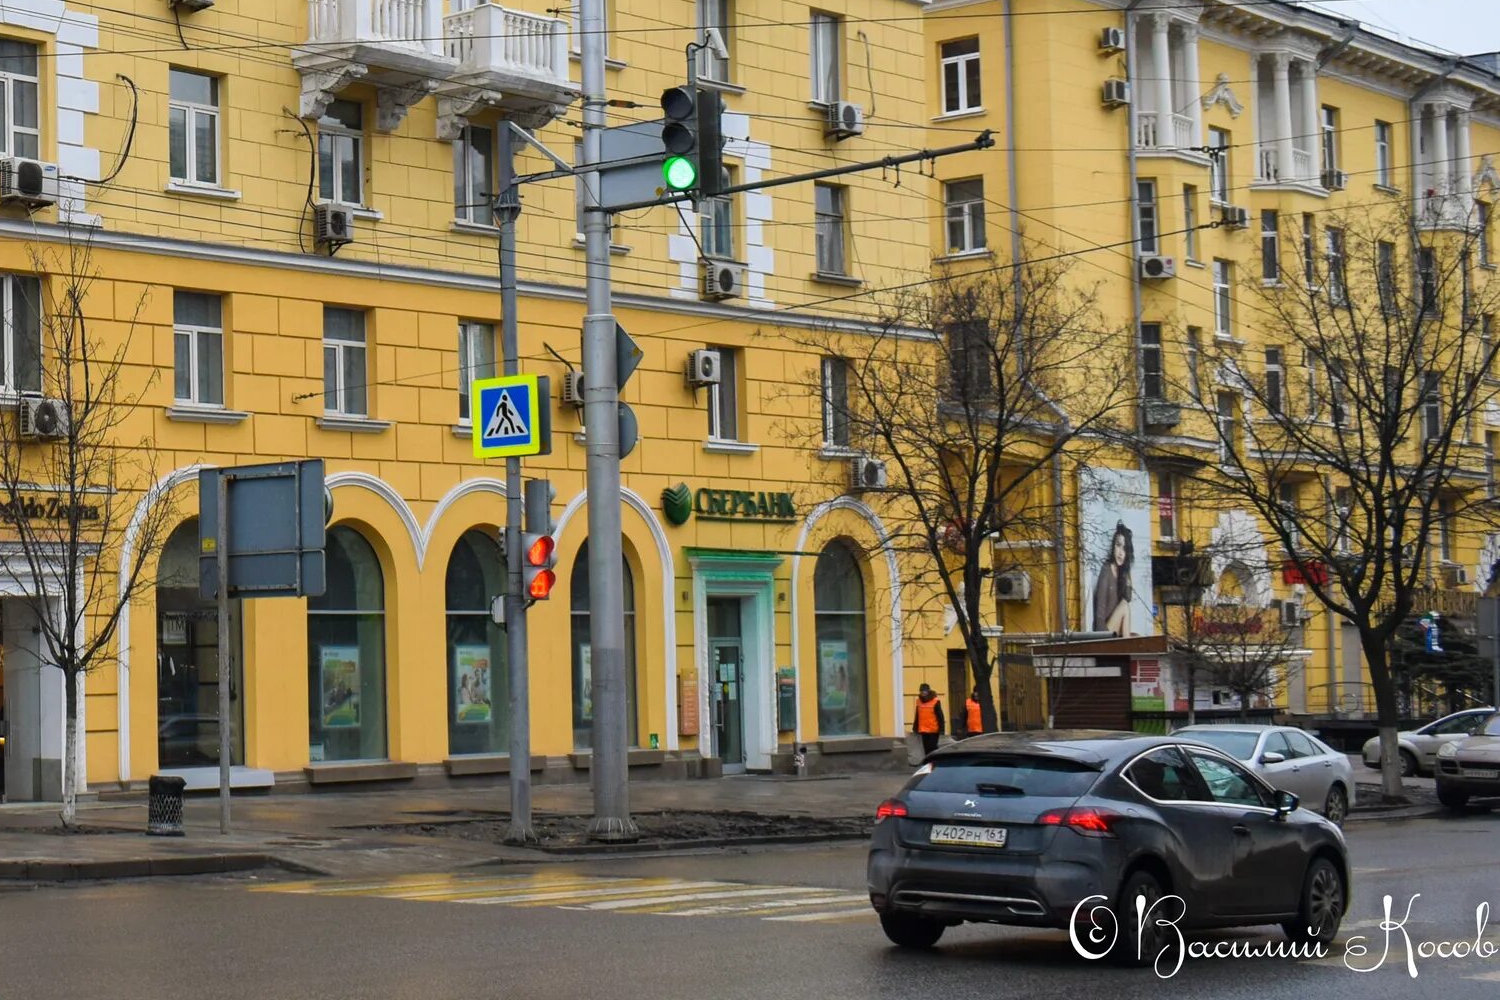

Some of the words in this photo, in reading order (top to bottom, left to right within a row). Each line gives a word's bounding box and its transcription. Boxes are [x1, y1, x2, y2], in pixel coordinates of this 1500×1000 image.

[46, 497, 99, 522] Zena
[695, 488, 796, 517] СБЕРБАНК
[935, 826, 981, 840] У402РН
